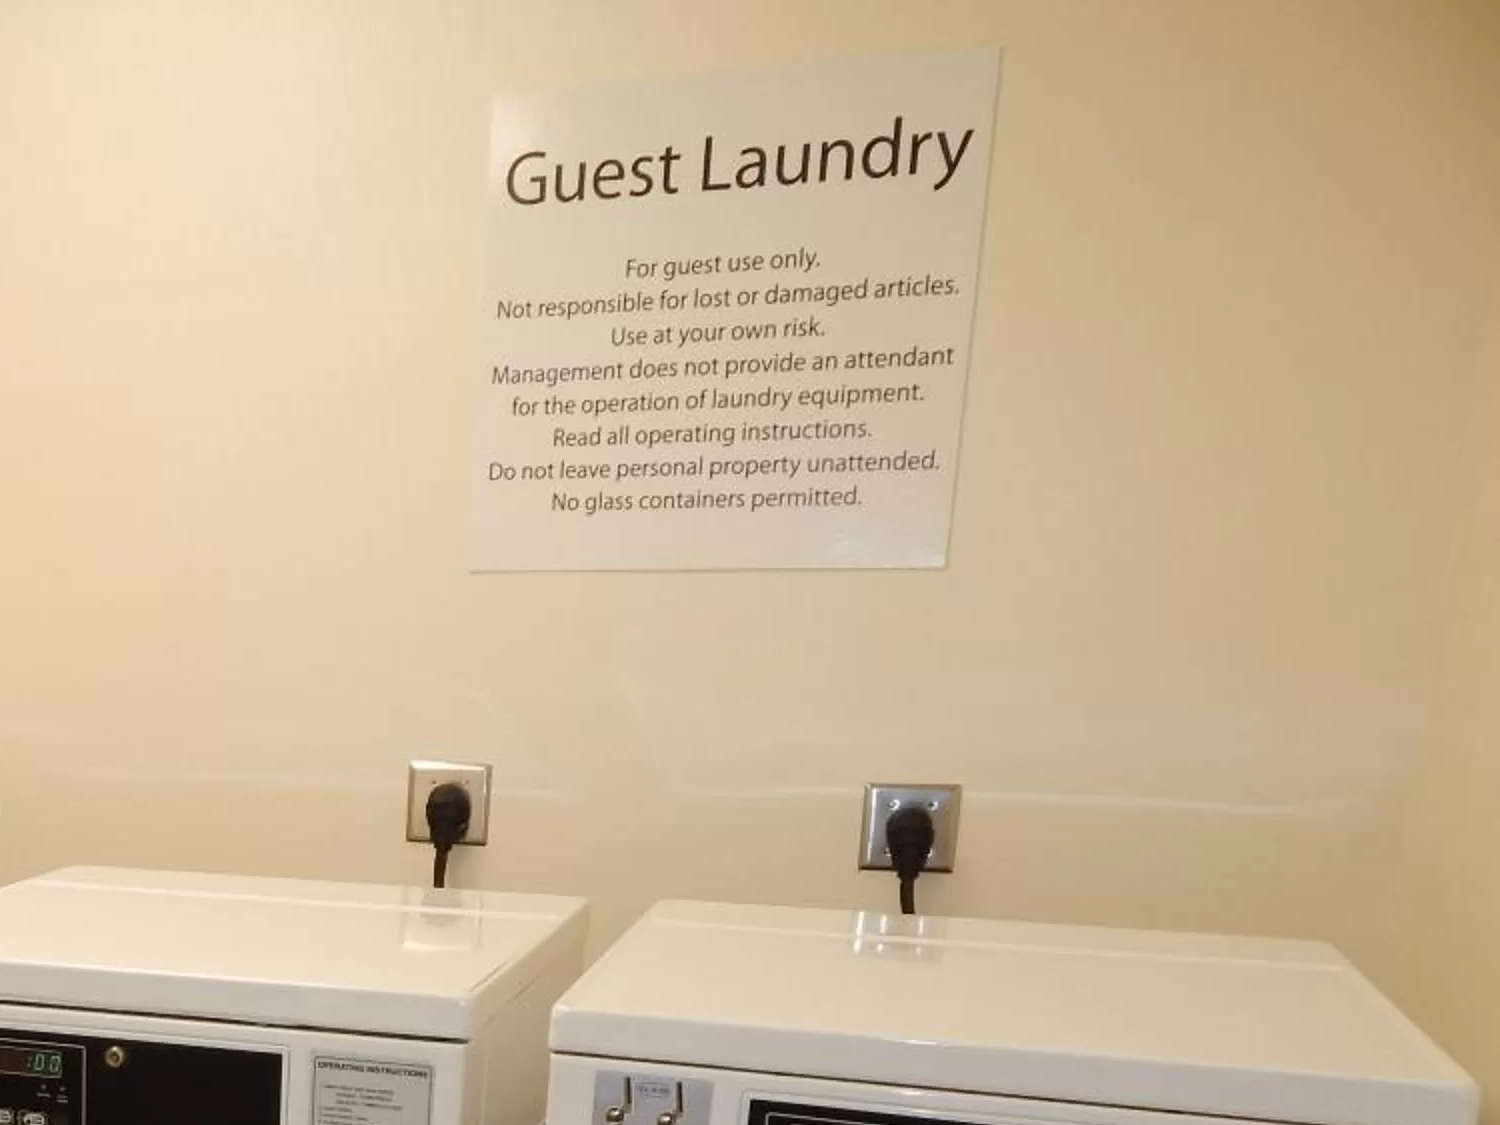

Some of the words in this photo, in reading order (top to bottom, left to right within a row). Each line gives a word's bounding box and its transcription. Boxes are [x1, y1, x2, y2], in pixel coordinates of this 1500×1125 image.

[506, 146, 682, 206] Guest
[701, 115, 975, 192] Laundry
[626, 258, 658, 278] For
[663, 256, 722, 281] guest
[728, 256, 764, 272] use
[770, 247, 820, 272] only.
[497, 300, 532, 320] Not
[538, 292, 654, 320] responsible
[660, 290, 688, 310] for
[694, 288, 732, 308] lost
[737, 290, 760, 306] or
[764, 278, 868, 306] damaged
[874, 274, 959, 298] articles.
[612, 326, 647, 347] Use
[653, 327, 673, 345] at
[678, 326, 726, 348] your
[731, 324, 777, 341] own
[783, 316, 825, 337] risk.
[492, 363, 624, 388] Management
[629, 358, 678, 379] does
[684, 358, 719, 376] not
[725, 352, 806, 379] provide
[812, 355, 838, 371] an
[844, 345, 954, 369] attendant
[512, 396, 539, 416] for
[544, 395, 576, 415] the
[581, 392, 679, 417] operation
[686, 388, 708, 410] of
[711, 386, 793, 411] laundry
[798, 384, 924, 410] equipment.
[553, 426, 602, 447] Read
[607, 425, 629, 445] all
[635, 424, 735, 448] operating
[742, 420, 872, 441] instructions.
[489, 462, 516, 481] Do
[521, 464, 554, 480] not
[559, 460, 611, 479] leave
[616, 456, 703, 482] personal
[709, 456, 801, 480] property
[807, 449, 940, 472] unattended.
[552, 492, 580, 511] No
[585, 491, 633, 516] glass
[639, 489, 745, 510] containers
[751, 484, 862, 512] permitted.
